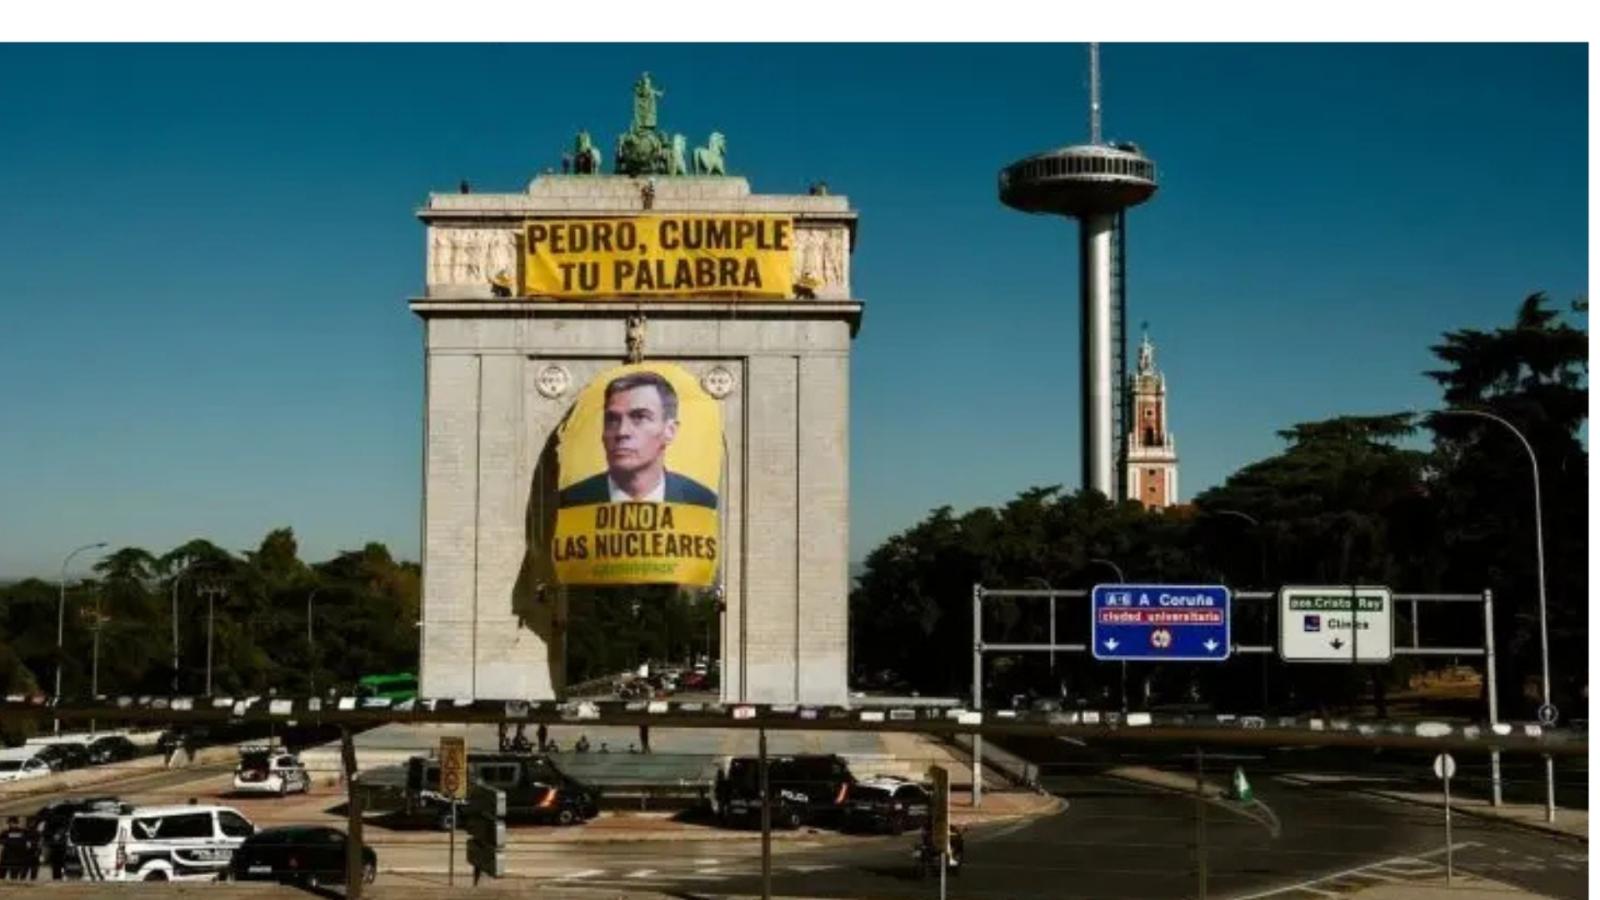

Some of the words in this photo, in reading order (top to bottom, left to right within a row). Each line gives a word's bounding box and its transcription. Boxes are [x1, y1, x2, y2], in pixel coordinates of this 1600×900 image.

[527, 222, 647, 255] PEDRO,
[659, 219, 790, 251] CUMPLE
[559, 263, 599, 291] TU
[614, 257, 762, 290] PALABRA
[597, 506, 616, 529] DI
[623, 504, 655, 530] NO
[661, 506, 674, 529] A
[554, 535, 588, 562] LAS
[595, 532, 716, 561] NUCLEARES
[1139, 593, 1150, 606] A
[1160, 593, 1214, 606] Coruña
